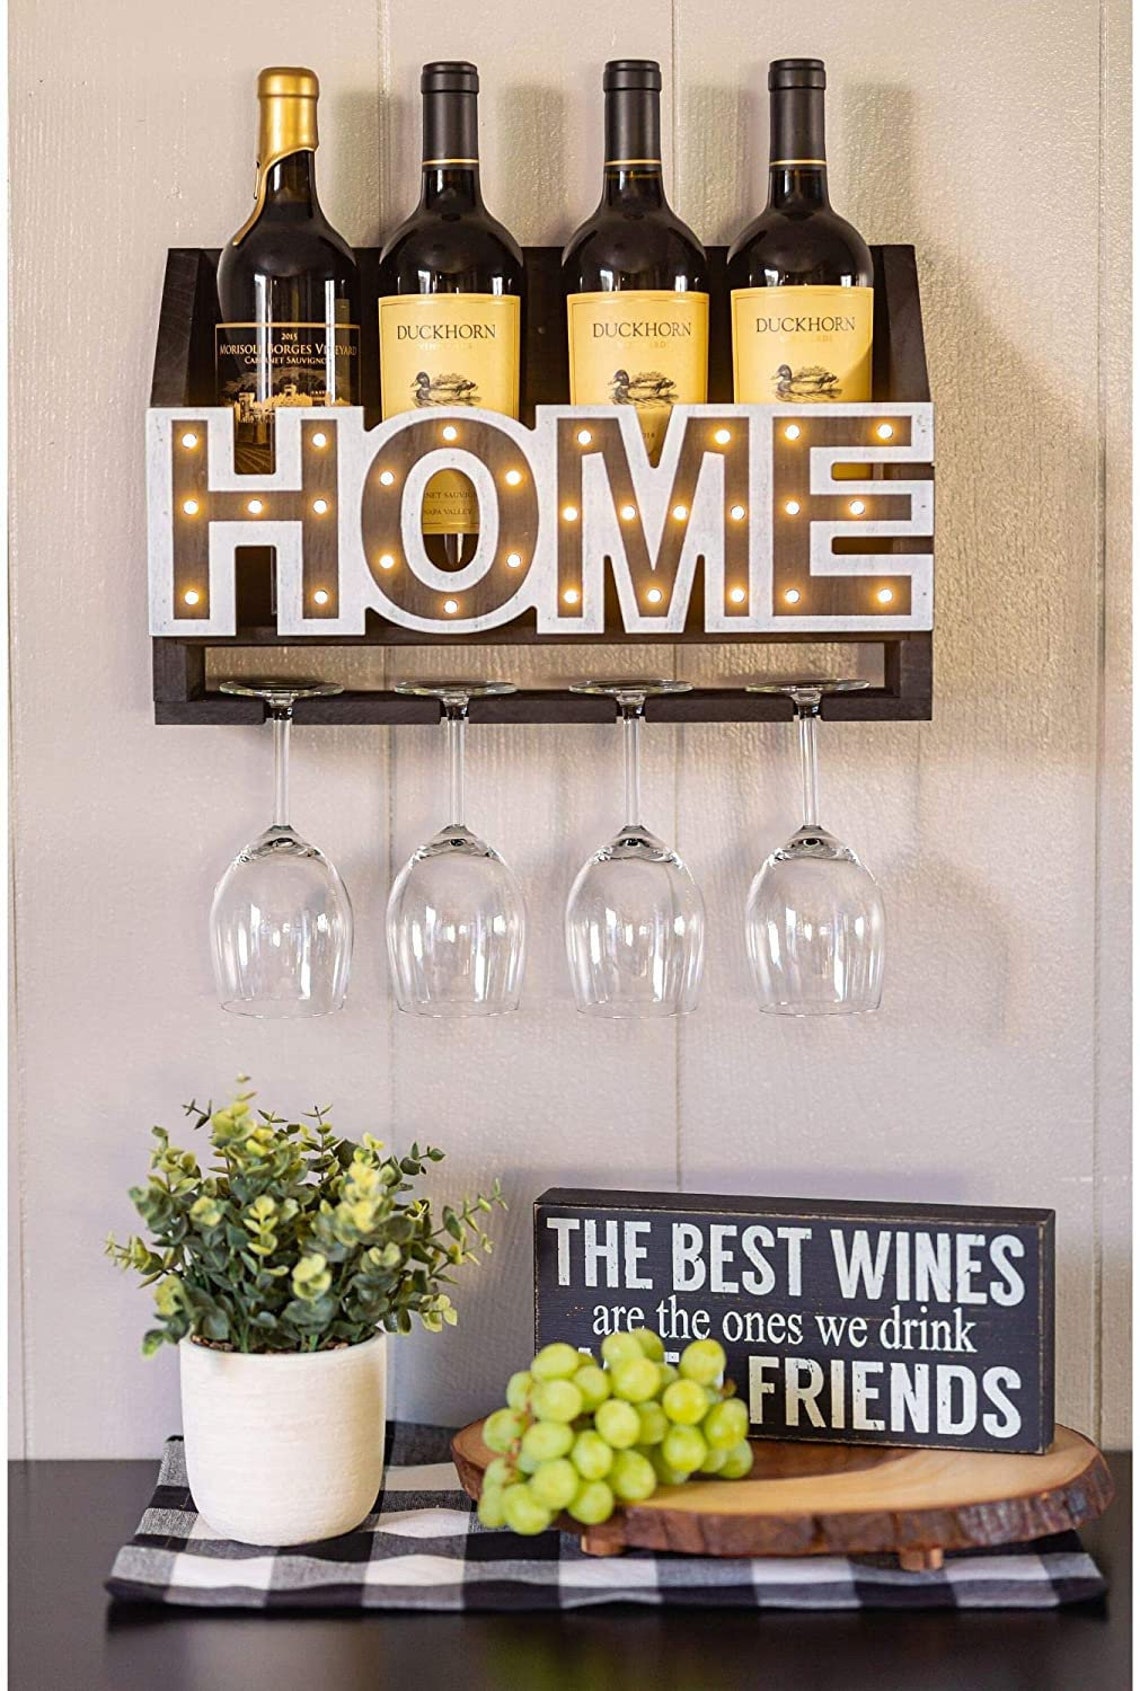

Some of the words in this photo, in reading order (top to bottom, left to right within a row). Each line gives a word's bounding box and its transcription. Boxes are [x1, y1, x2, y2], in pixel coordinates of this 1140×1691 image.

[396, 324, 497, 340] DUCKHORN
[592, 321, 692, 338] DUCKHORN
[754, 316, 855, 333] DUCKHORN
[146, 402, 934, 637] HOME
[546, 1217, 653, 1290] THE
[672, 1222, 812, 1297] BEST
[830, 1228, 1026, 1307] WINES
[592, 1304, 645, 1336] are
[656, 1294, 710, 1340] the
[722, 1310, 803, 1346] ones
[815, 1315, 868, 1348] we
[879, 1304, 978, 1353] drink
[749, 1355, 1022, 1439] FRIENDS
